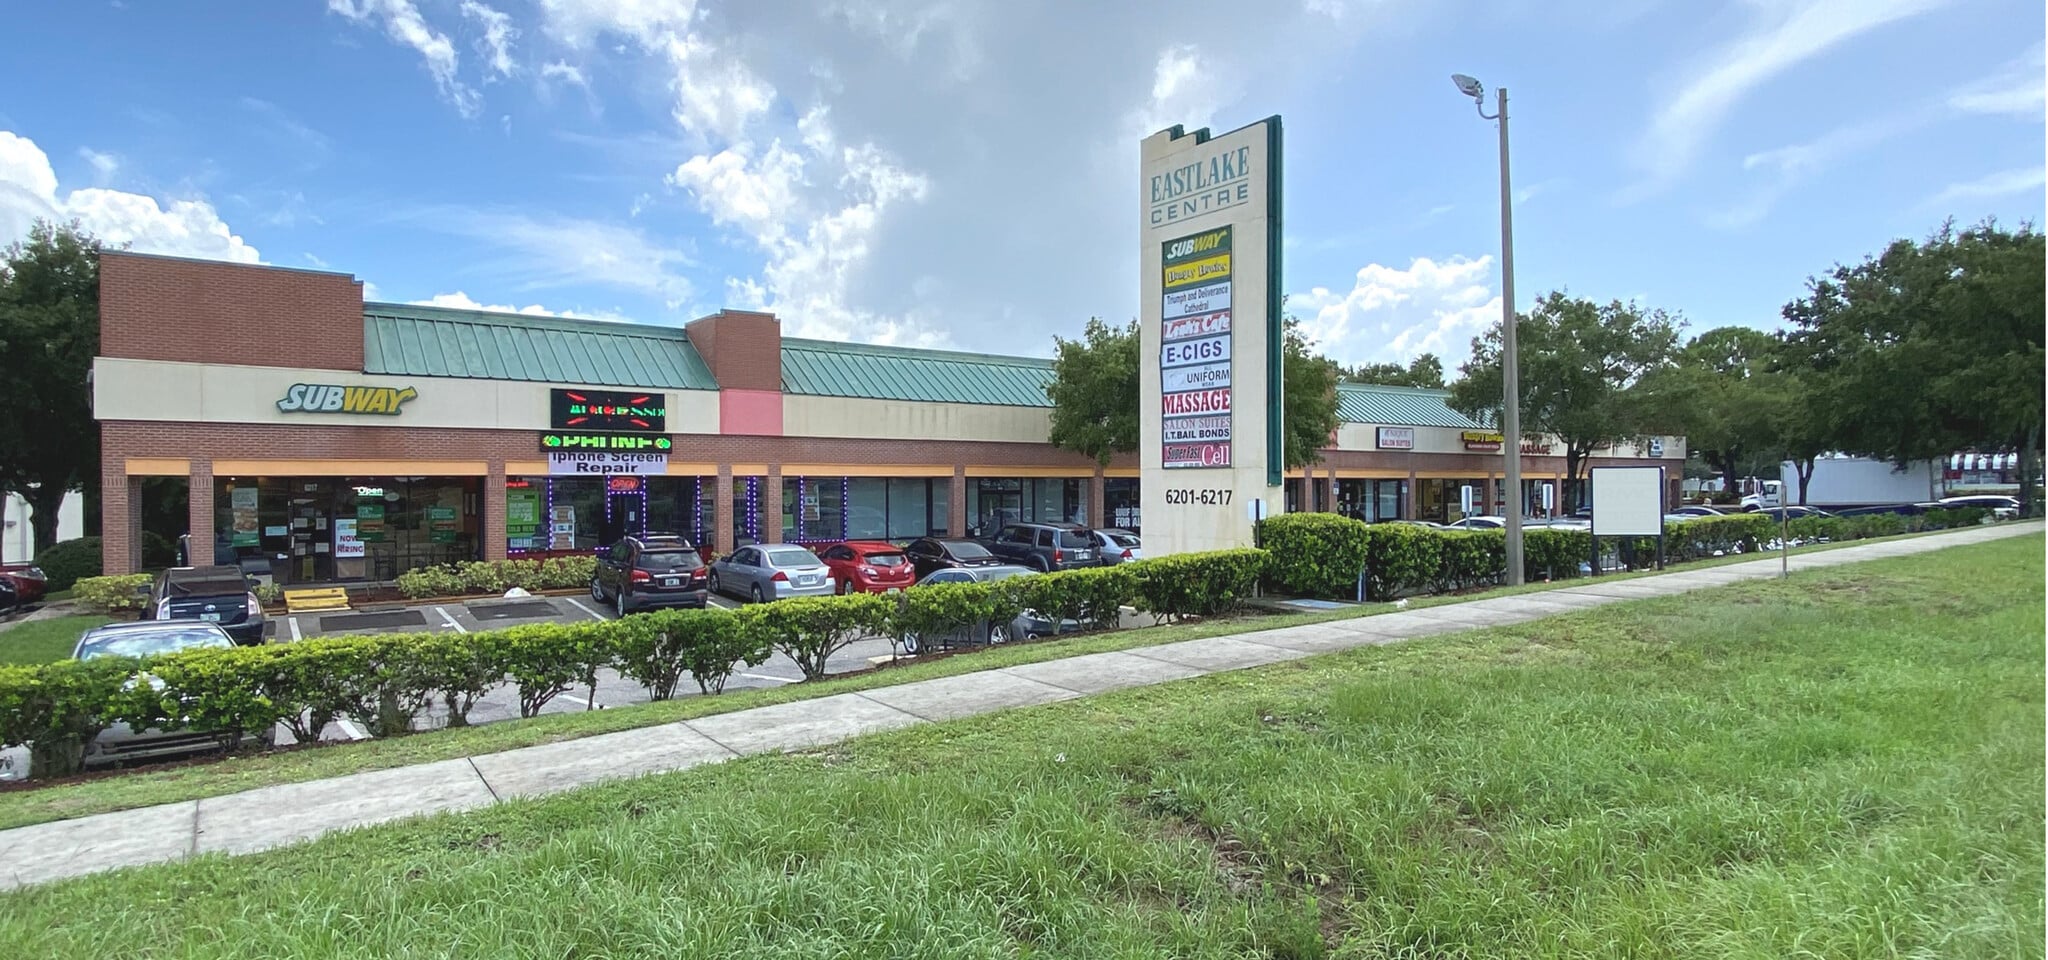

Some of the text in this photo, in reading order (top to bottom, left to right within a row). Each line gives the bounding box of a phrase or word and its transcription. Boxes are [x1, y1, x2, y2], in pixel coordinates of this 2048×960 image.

[1151, 146, 1249, 203] EASTLAKE
[1151, 184, 1248, 224] CENTRE
[1167, 230, 1227, 259] SUBWAY
[1188, 290, 1197, 300] and
[1198, 286, 1228, 299] Deliverance
[1184, 301, 1209, 313] Cathedral
[1167, 341, 1222, 362] E-CIGS
[1187, 369, 1229, 383] UNIFORM
[277, 383, 417, 414] SUBWAY
[1163, 389, 1230, 414] MASSAGE
[1164, 416, 1230, 430] SALON SUITES
[1199, 428, 1230, 438] BONDS
[553, 452, 663, 464] Iphone Screen
[1202, 444, 1230, 466] Cell
[576, 463, 638, 474] Repair
[357, 486, 383, 496] Open
[611, 480, 636, 489] OPEN
[1166, 489, 1232, 505] 6201-6217
[1116, 517, 1130, 527] FOR
